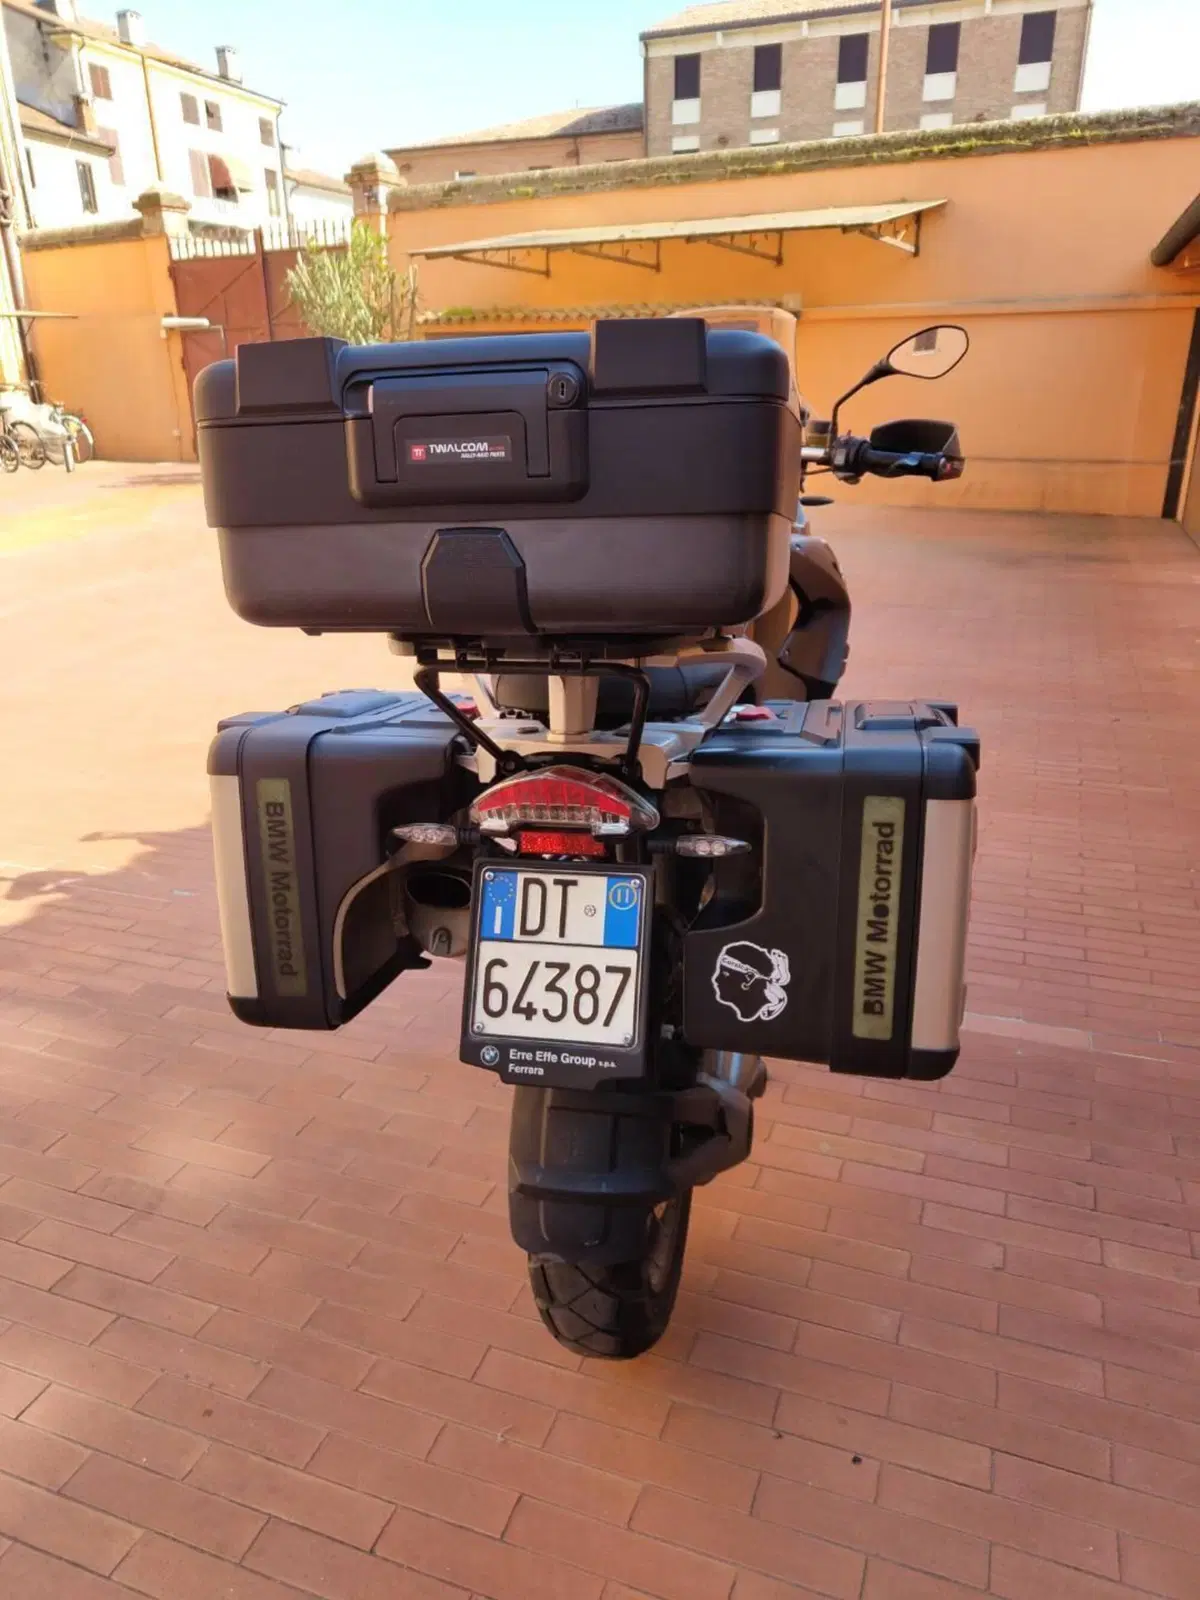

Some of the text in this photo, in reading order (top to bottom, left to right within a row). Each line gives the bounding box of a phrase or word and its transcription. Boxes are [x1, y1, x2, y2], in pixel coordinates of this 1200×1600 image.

[429, 442, 488, 453] TWALCOM
[265, 801, 298, 977] BMW Motorrad
[519, 877, 579, 938] DT
[863, 821, 895, 1017] BMW Motorrad
[482, 958, 632, 1027] 64387
[508, 1063, 544, 1075] Ferrara
[509, 1049, 533, 1060] Erre
[535, 1051, 558, 1063] Effe
[560, 1053, 596, 1067] Group
